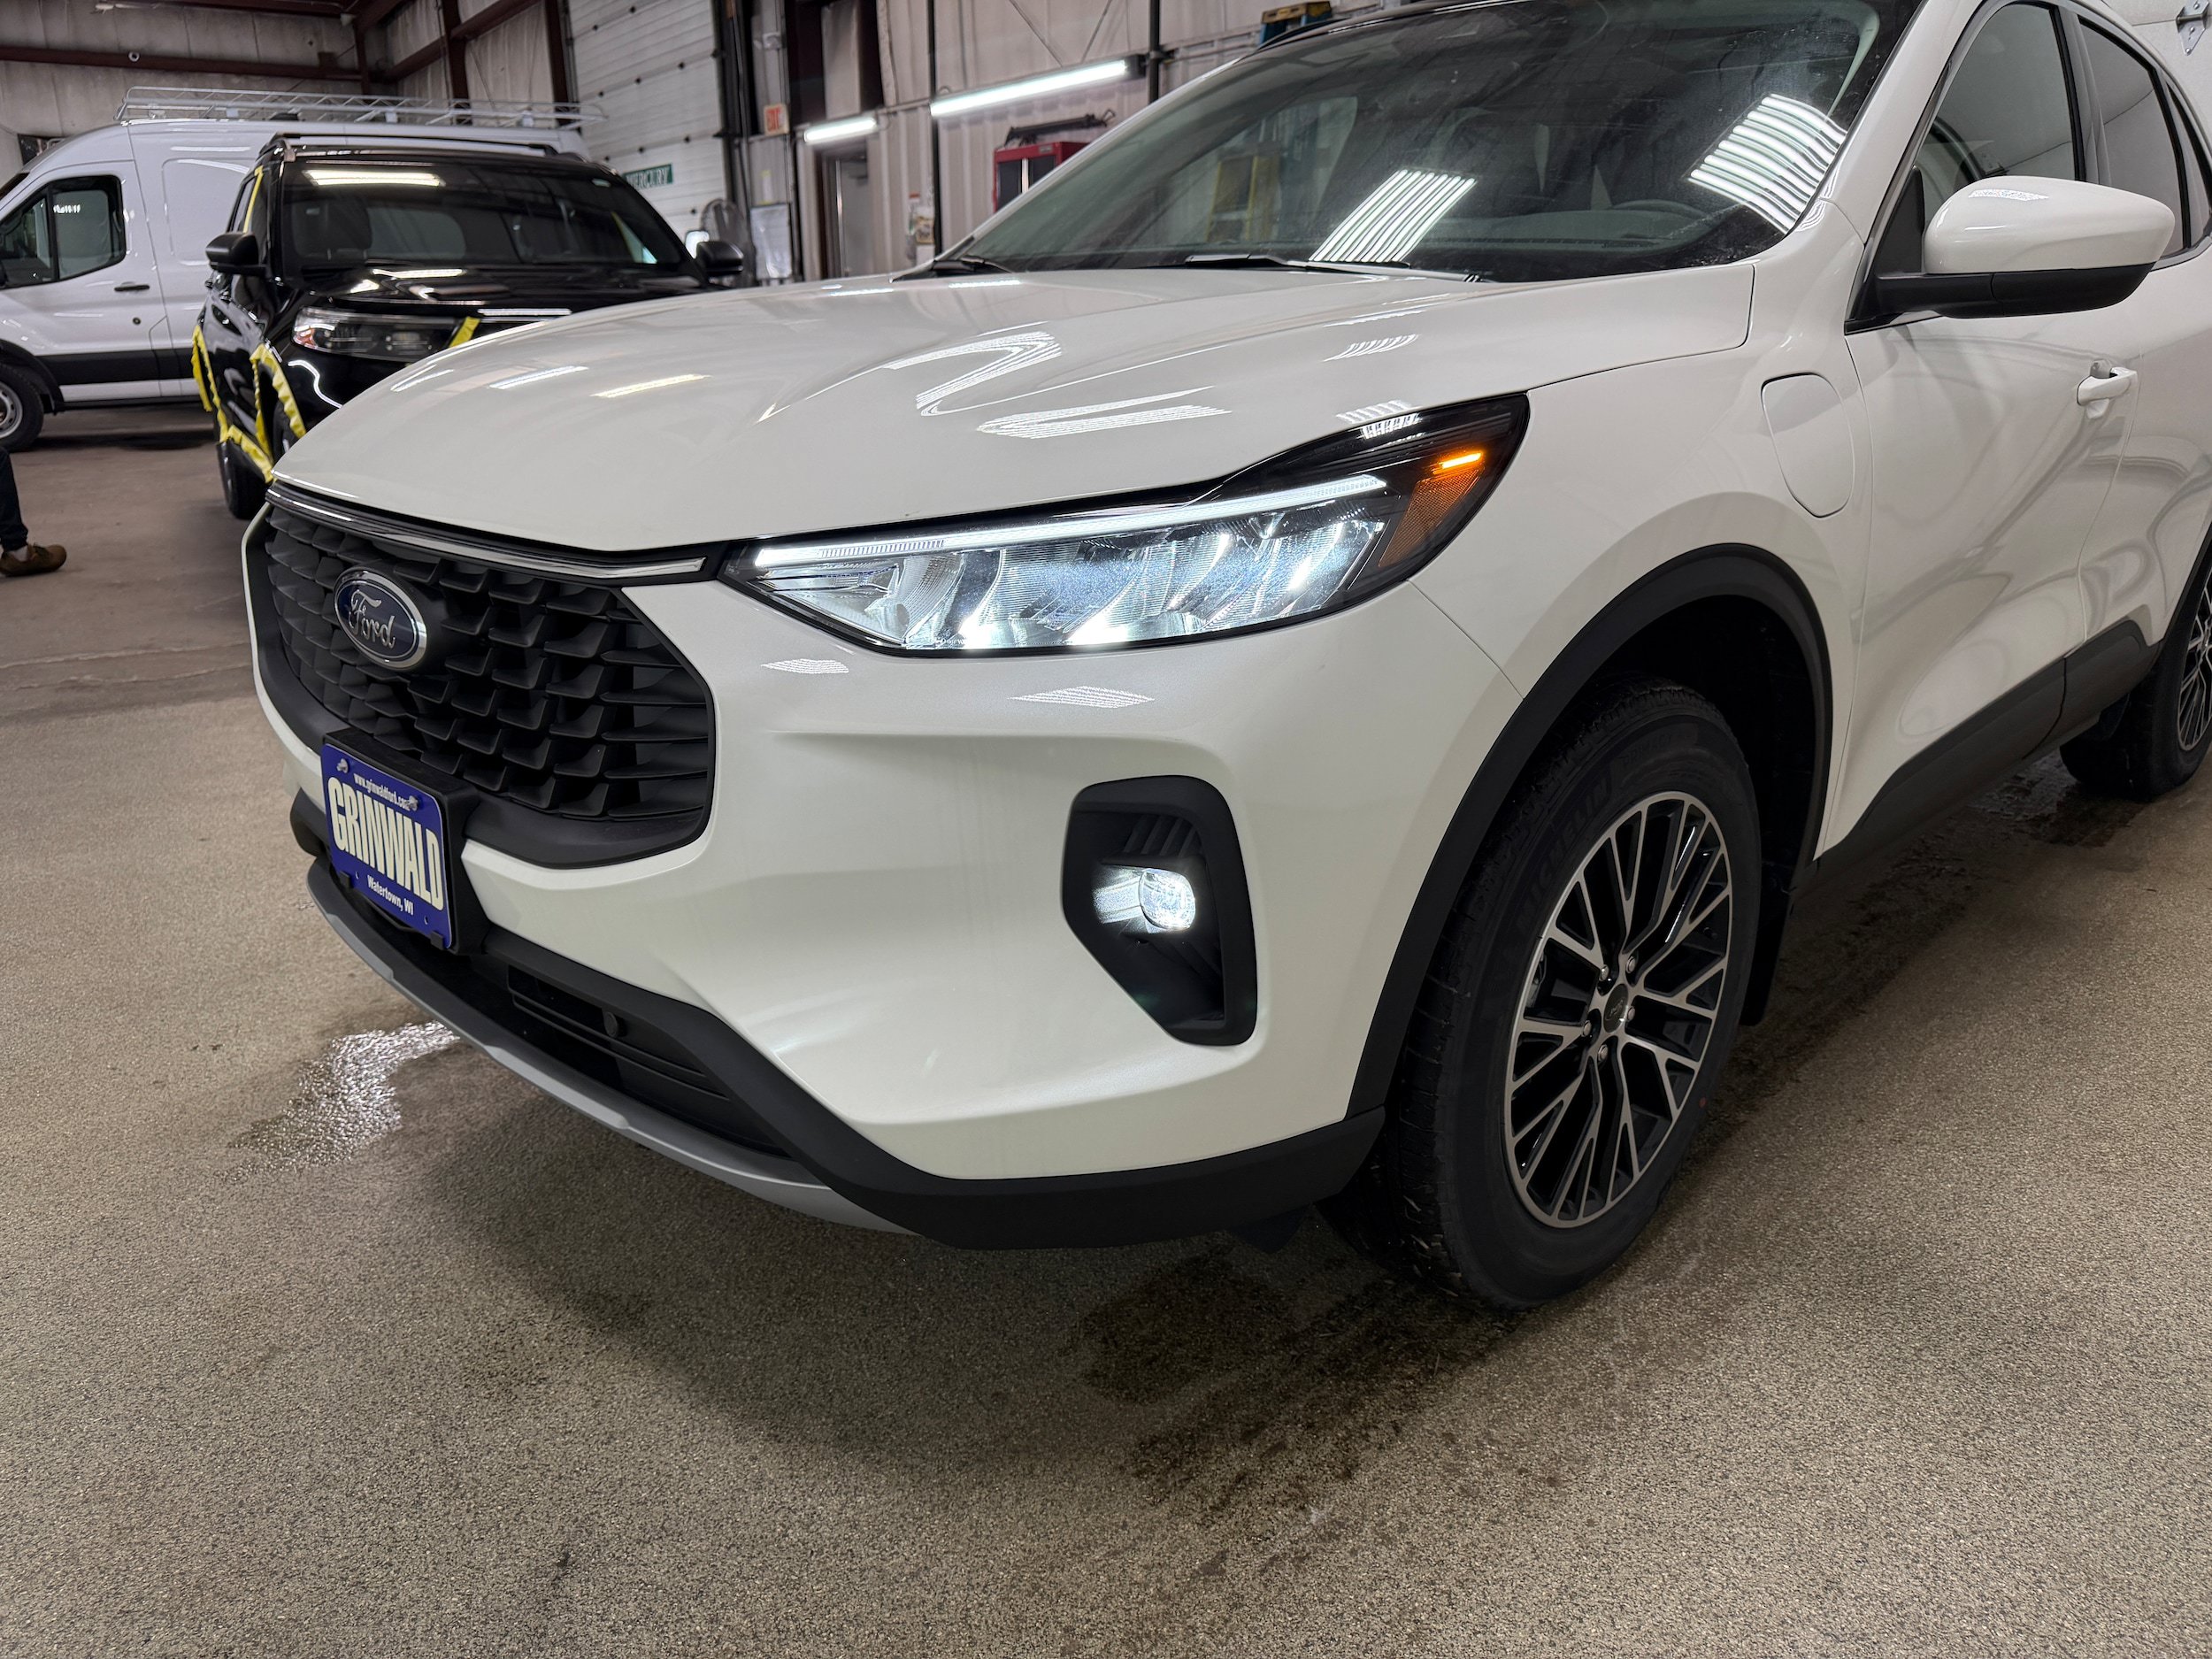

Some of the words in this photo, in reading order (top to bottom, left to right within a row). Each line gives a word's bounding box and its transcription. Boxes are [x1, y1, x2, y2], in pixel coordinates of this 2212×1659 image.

[349, 588, 396, 649] Ford
[328, 777, 444, 911] GRINWALD
[366, 874, 403, 912] Watertown,
[403, 898, 414, 916] WI
